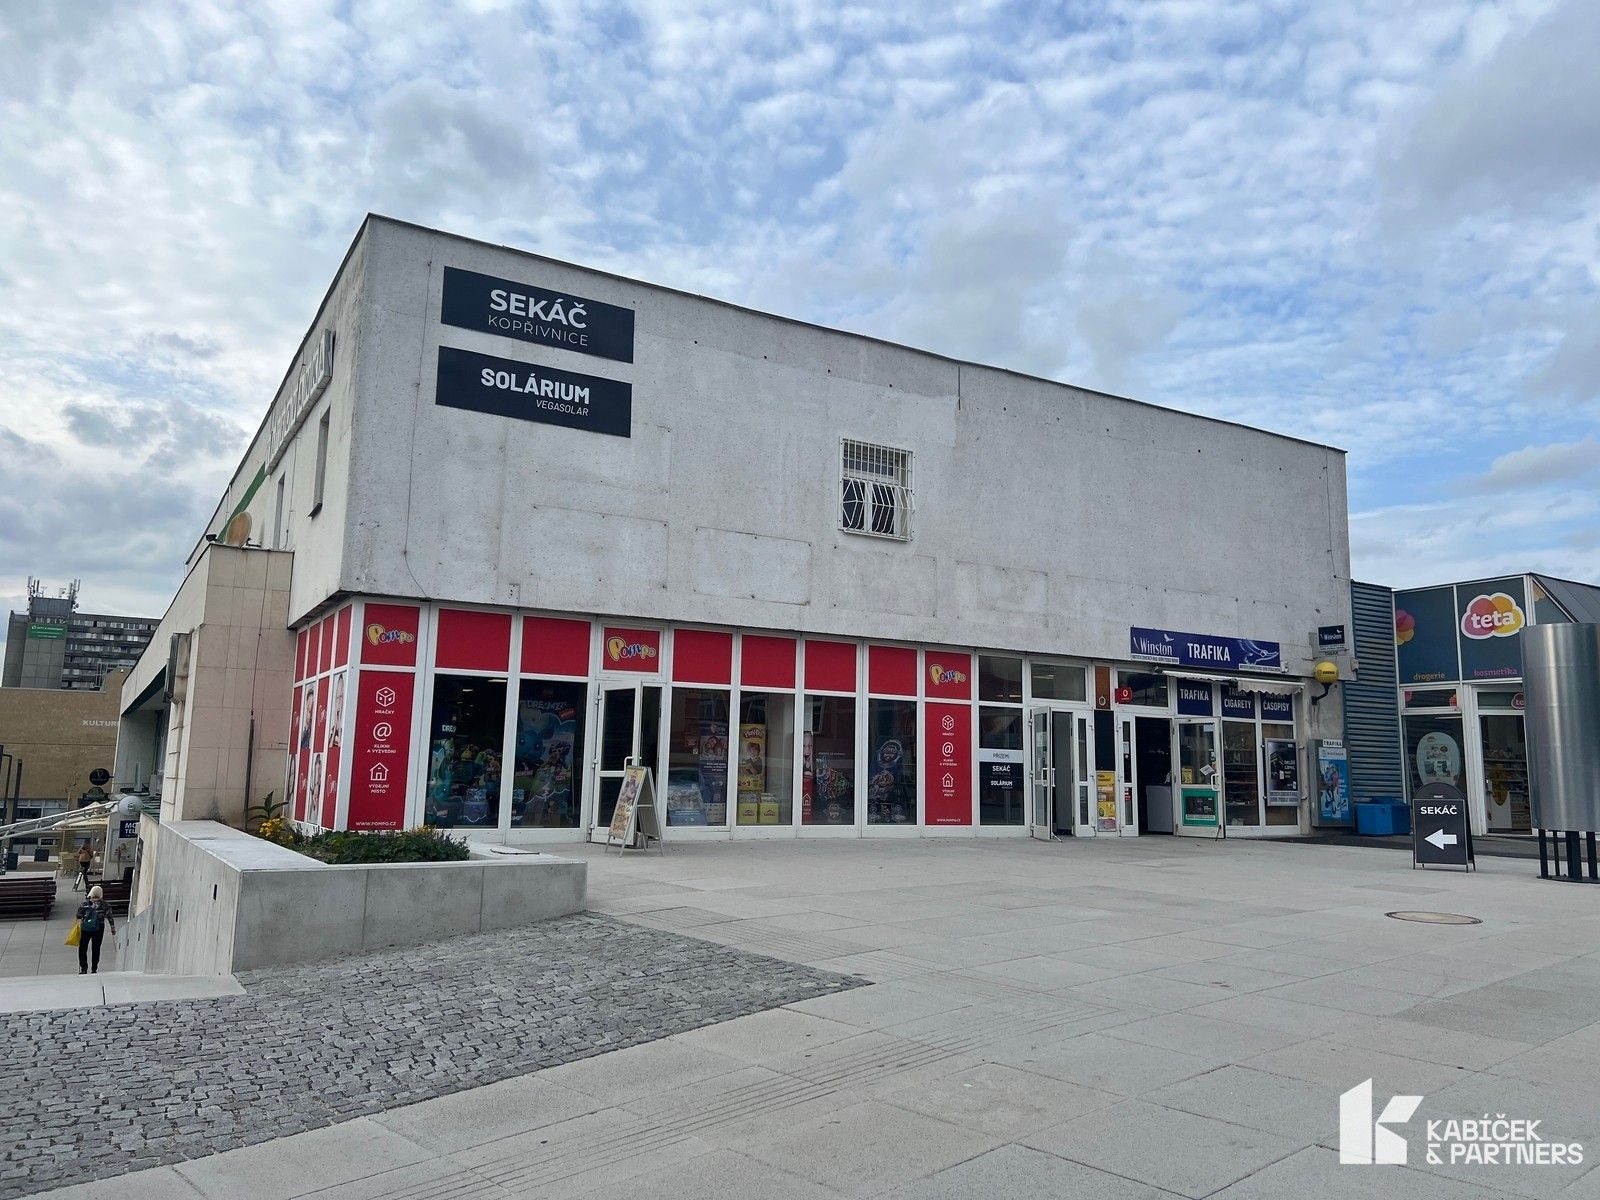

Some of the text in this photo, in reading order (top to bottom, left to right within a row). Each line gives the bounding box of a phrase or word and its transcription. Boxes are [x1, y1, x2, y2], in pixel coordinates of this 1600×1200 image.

[489, 288, 588, 329] SEKÁČ
[488, 314, 588, 347] KOPŘIVNICE
[480, 367, 590, 405] SOLÁRIUM
[536, 399, 589, 417] VEGASOLAR
[1470, 610, 1516, 629] teta
[1132, 636, 1173, 656] Winston
[1187, 642, 1231, 662] TRAFIKA
[1413, 672, 1446, 681] drogerie
[1474, 667, 1518, 677] kosmetika
[1179, 688, 1210, 701] TRAFIKA
[1224, 698, 1252, 710] CIGARETY
[1263, 700, 1290, 712] ČASOPISY
[1420, 804, 1458, 815] SEKÁČ
